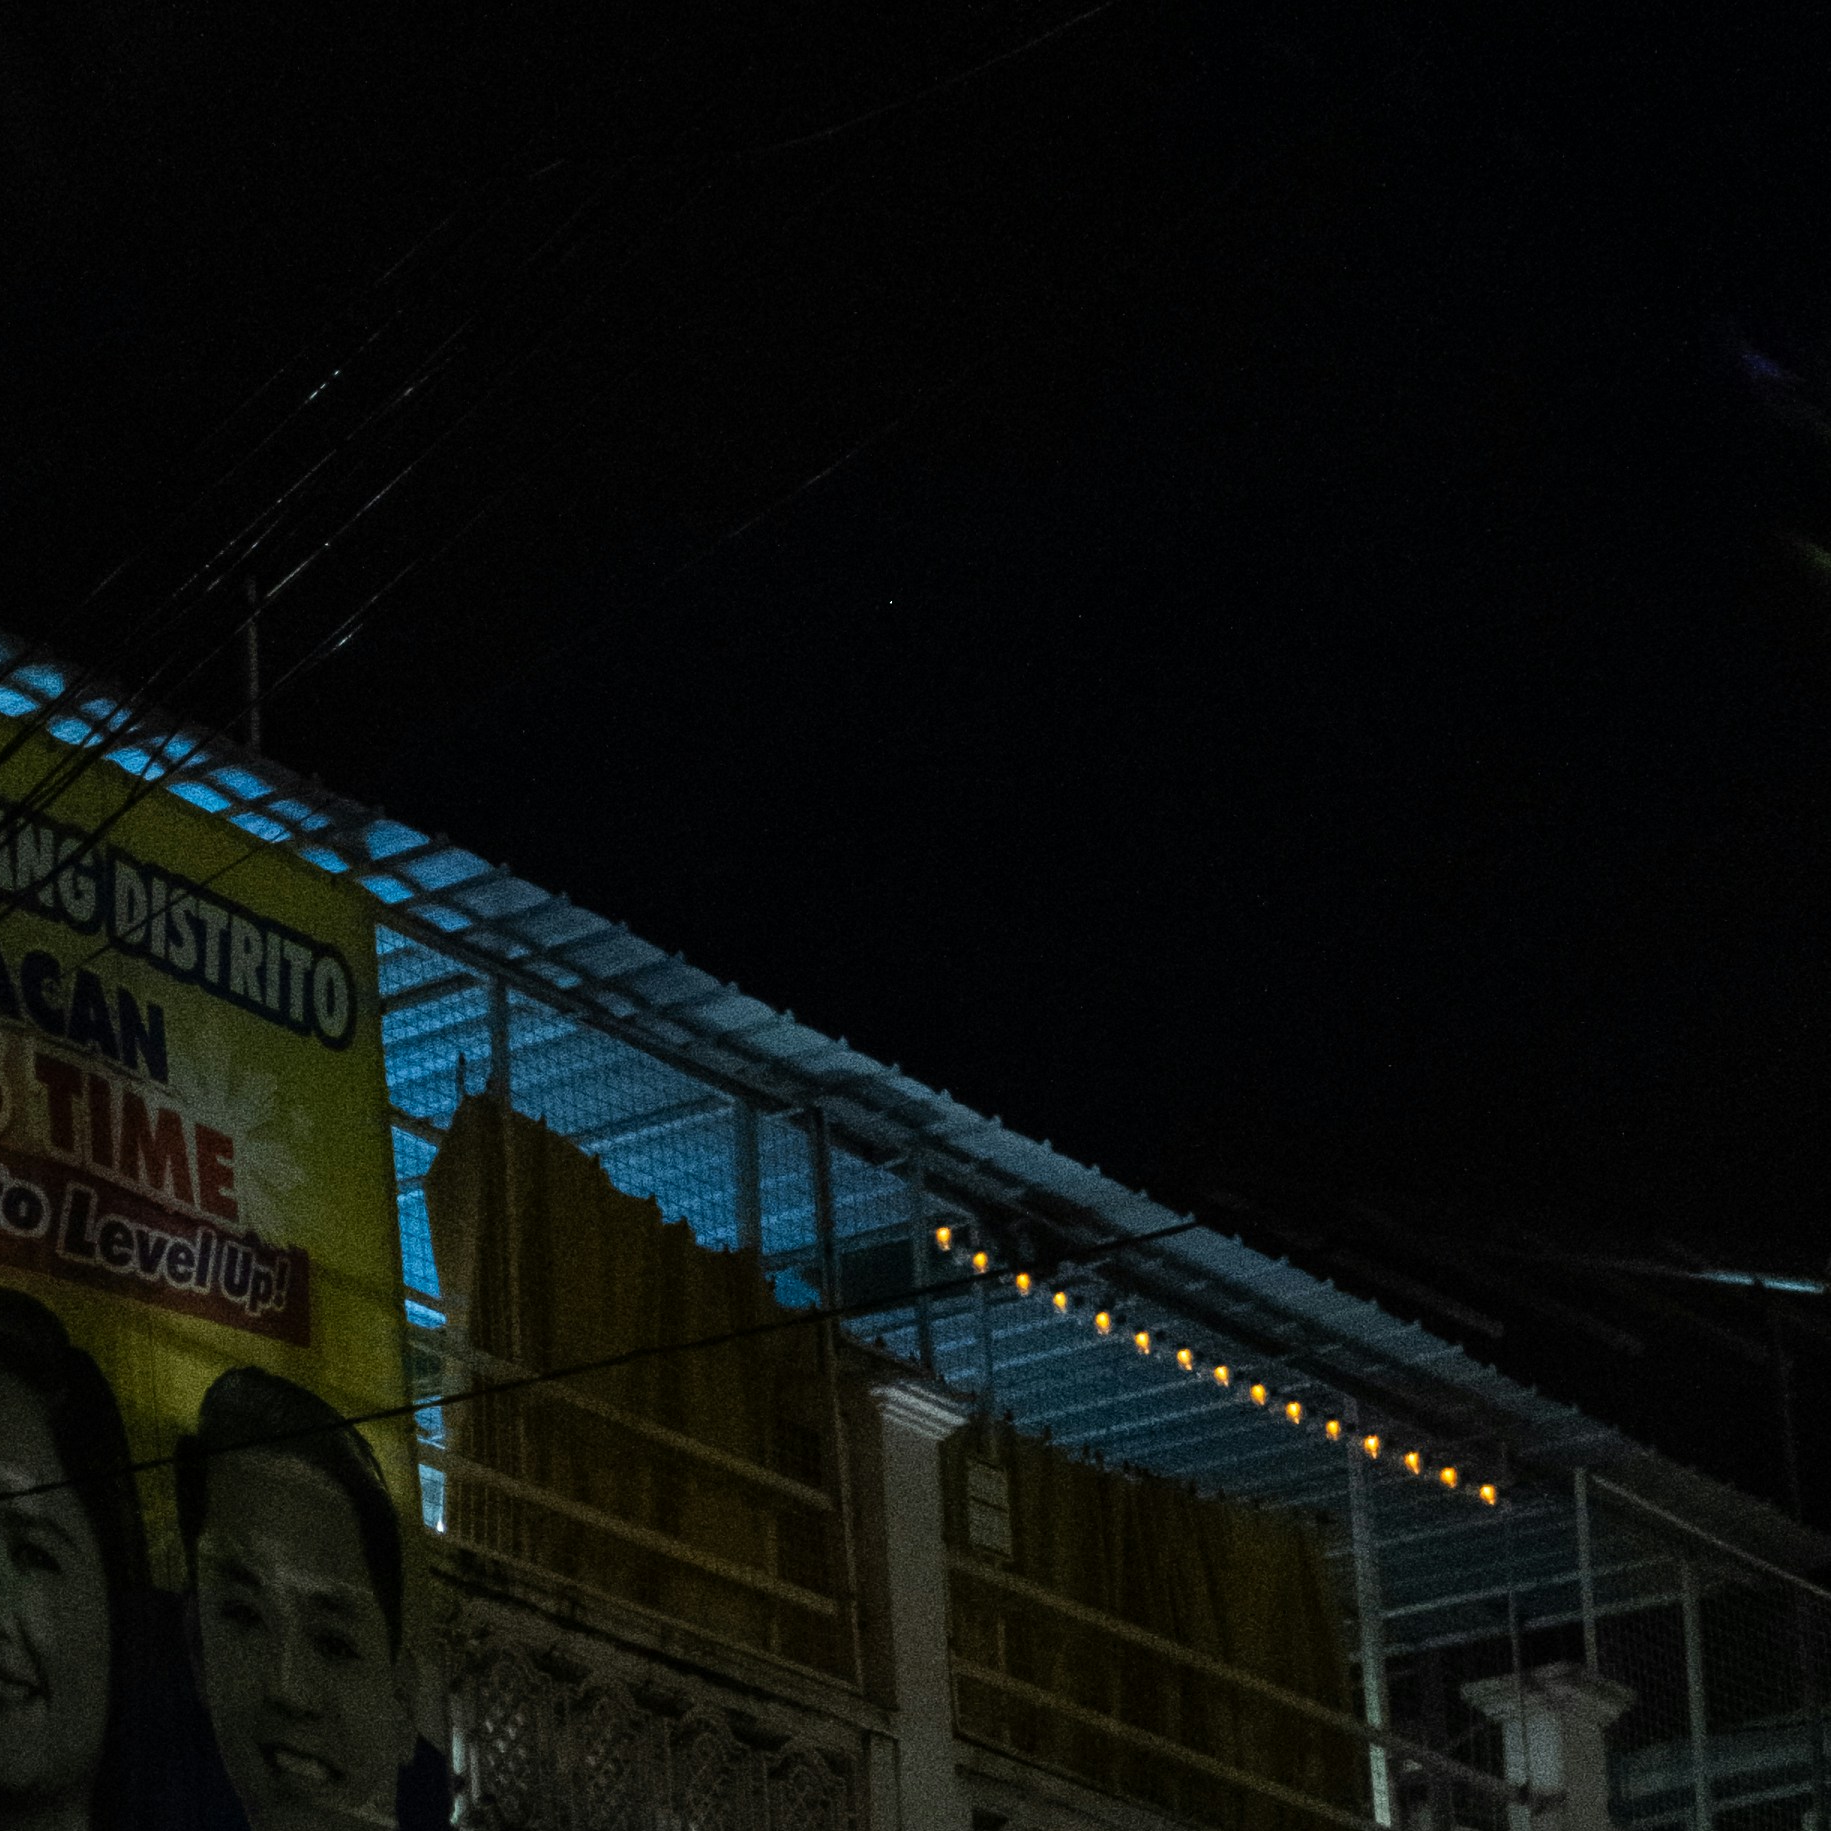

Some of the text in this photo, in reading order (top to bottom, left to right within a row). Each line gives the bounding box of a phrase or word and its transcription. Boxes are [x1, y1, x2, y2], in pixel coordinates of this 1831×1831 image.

[113, 866, 354, 1040] DISTRITO
[36, 1058, 238, 1219] TIME
[66, 1188, 213, 1295] Level
[223, 1235, 290, 1317] Up!
